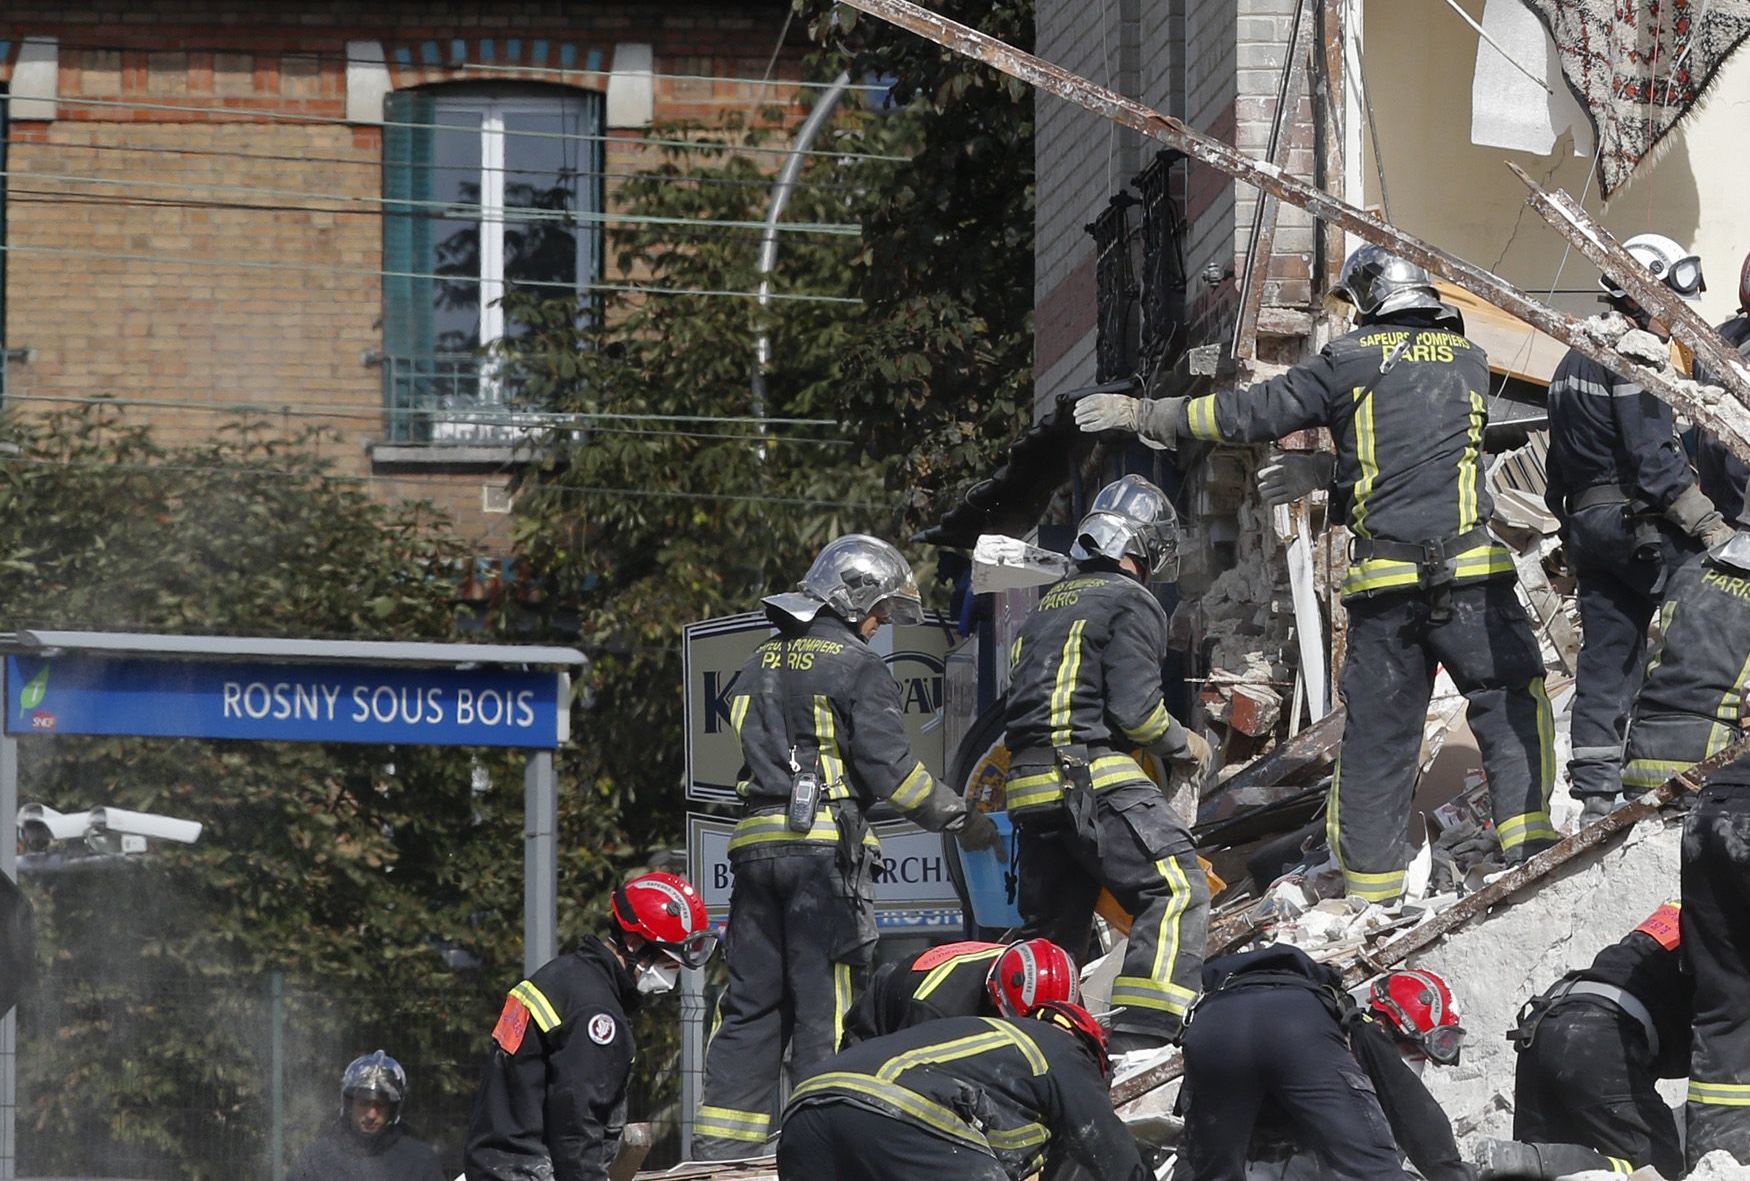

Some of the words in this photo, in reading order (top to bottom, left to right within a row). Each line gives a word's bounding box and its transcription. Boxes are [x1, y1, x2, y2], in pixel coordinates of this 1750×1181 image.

[1038, 589, 1081, 612] PARIS
[791, 638, 844, 656] POMPIERS
[761, 651, 815, 670] PARIS
[223, 681, 341, 721] ROSNY
[352, 685, 444, 724] SOUS
[456, 688, 535, 727] BOIS
